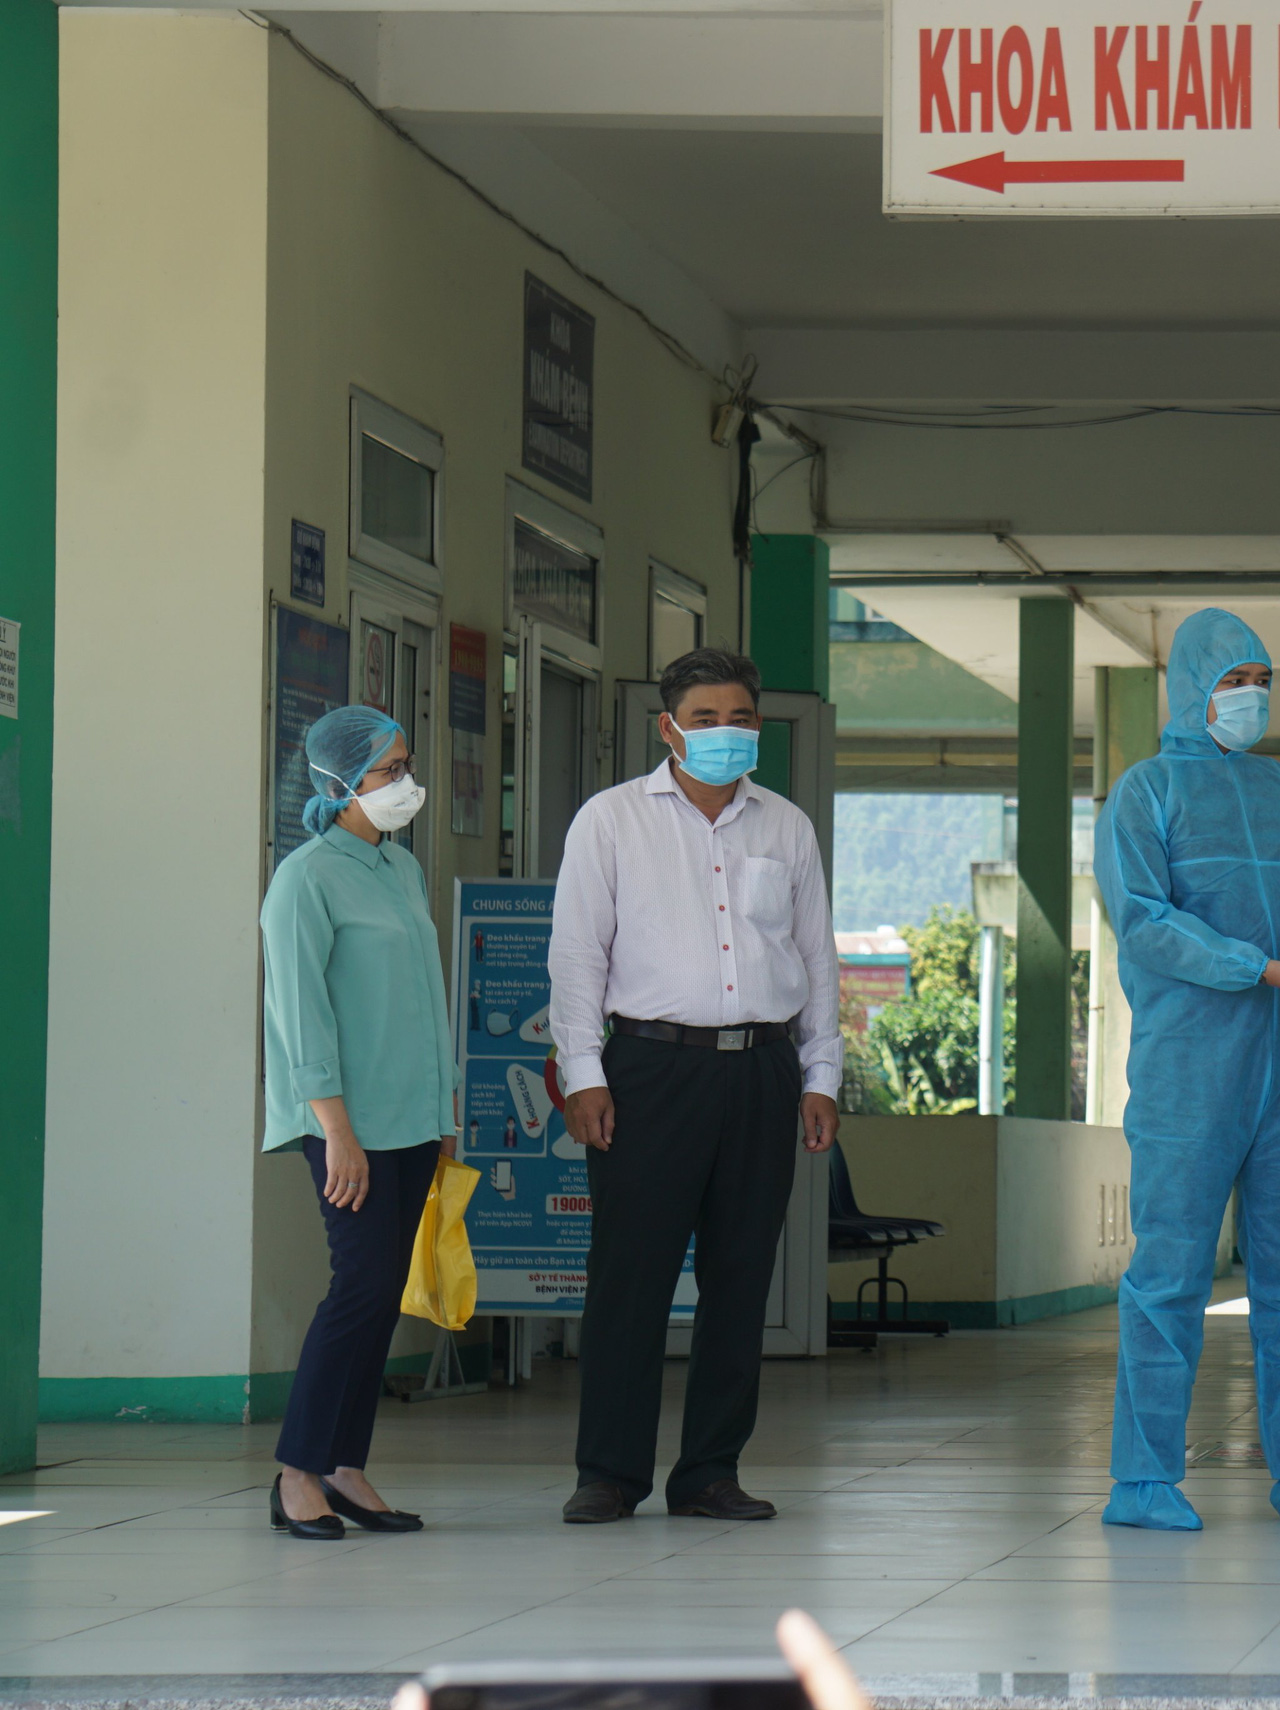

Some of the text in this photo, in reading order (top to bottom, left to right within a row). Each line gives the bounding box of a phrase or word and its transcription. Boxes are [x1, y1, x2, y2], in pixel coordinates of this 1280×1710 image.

[919, 25, 1072, 136] KHOA
[1094, 0, 1253, 132] KHÁM
[530, 348, 561, 416] KHÁM
[472, 900, 512, 911] CHUNG
[514, 897, 545, 911] SỐNG
[552, 1197, 592, 1211] 19009
[535, 1257, 549, 1266] cho
[535, 1284, 558, 1295] BỆNH
[559, 1285, 579, 1296] VIỆN
